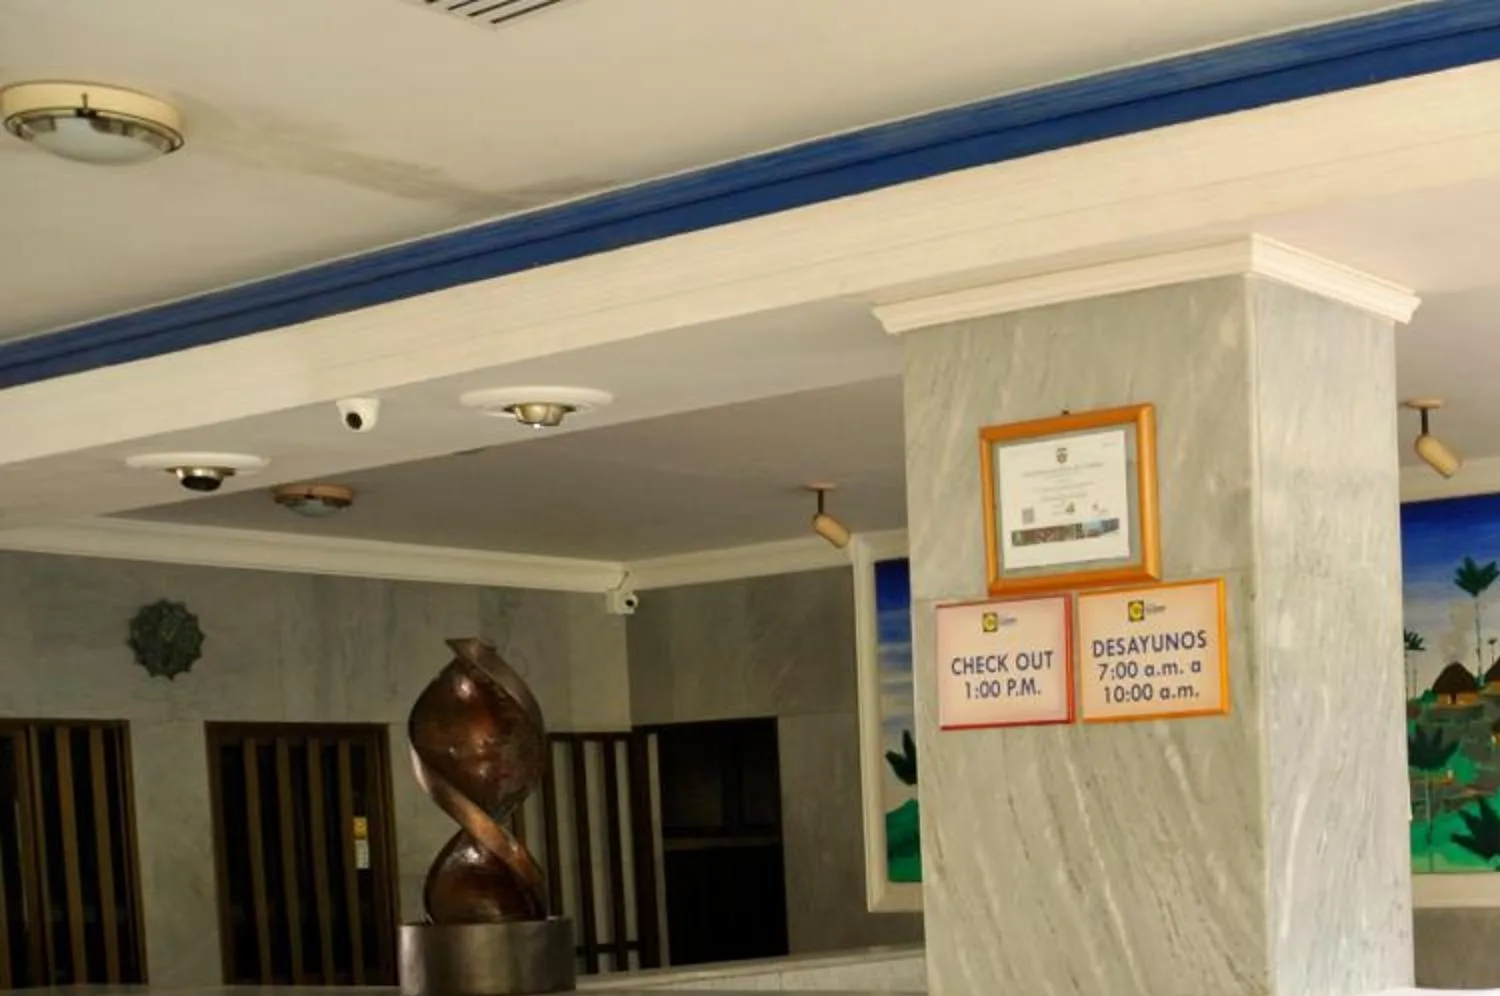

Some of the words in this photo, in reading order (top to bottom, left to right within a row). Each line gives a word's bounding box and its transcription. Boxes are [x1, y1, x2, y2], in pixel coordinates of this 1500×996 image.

[1092, 630, 1207, 658] DESAYUNOS
[951, 654, 1008, 676] CHECK
[1016, 650, 1054, 672] OUT
[1098, 661, 1138, 681] 7:00
[1144, 661, 1184, 677] a.m.
[1191, 659, 1201, 673] a
[964, 680, 1001, 700] 1:00
[1007, 677, 1042, 697] P.M.
[1103, 684, 1154, 704] 10:00
[1159, 685, 1200, 700] a.m.
